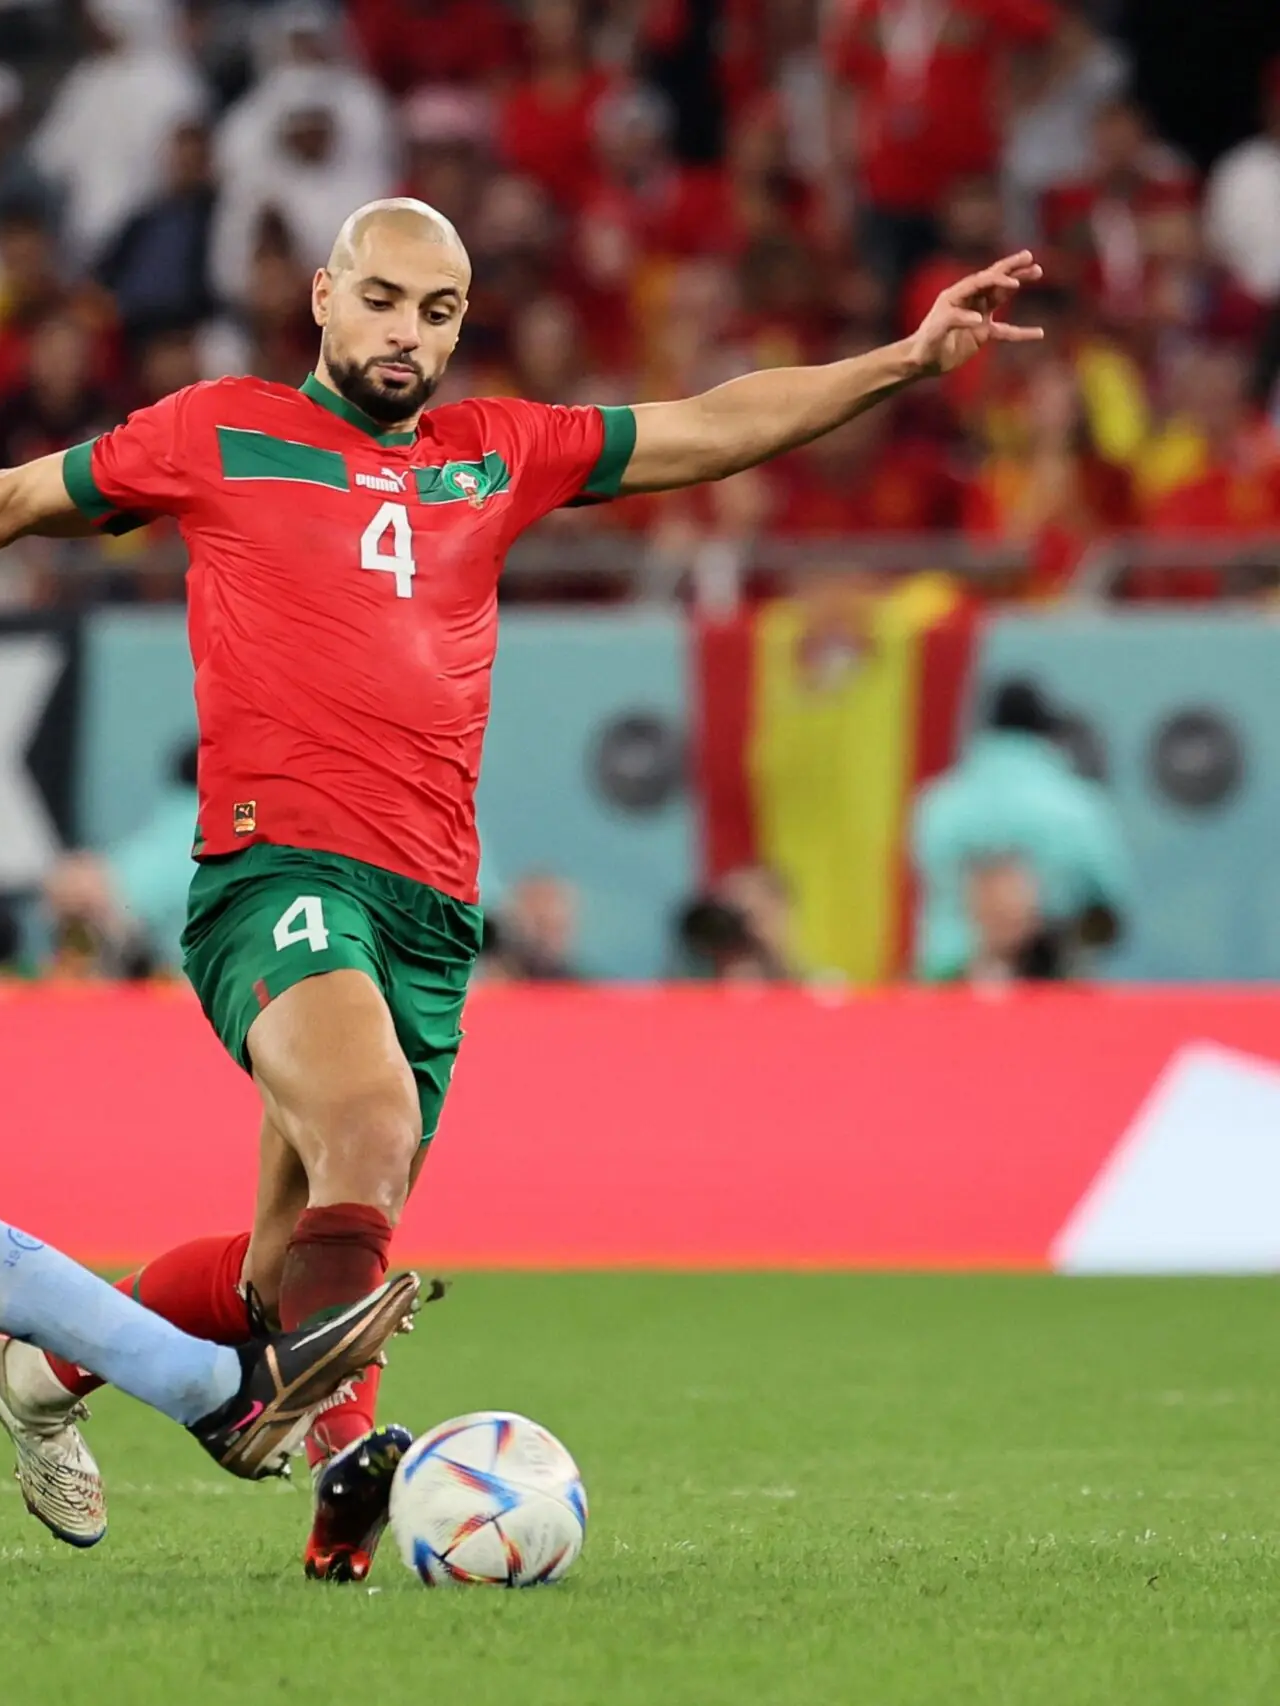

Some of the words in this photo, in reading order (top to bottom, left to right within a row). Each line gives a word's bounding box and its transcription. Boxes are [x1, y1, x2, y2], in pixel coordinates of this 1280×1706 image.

[355, 473, 400, 493] PUMA
[360, 501, 416, 599] 4
[272, 895, 329, 952] 4
